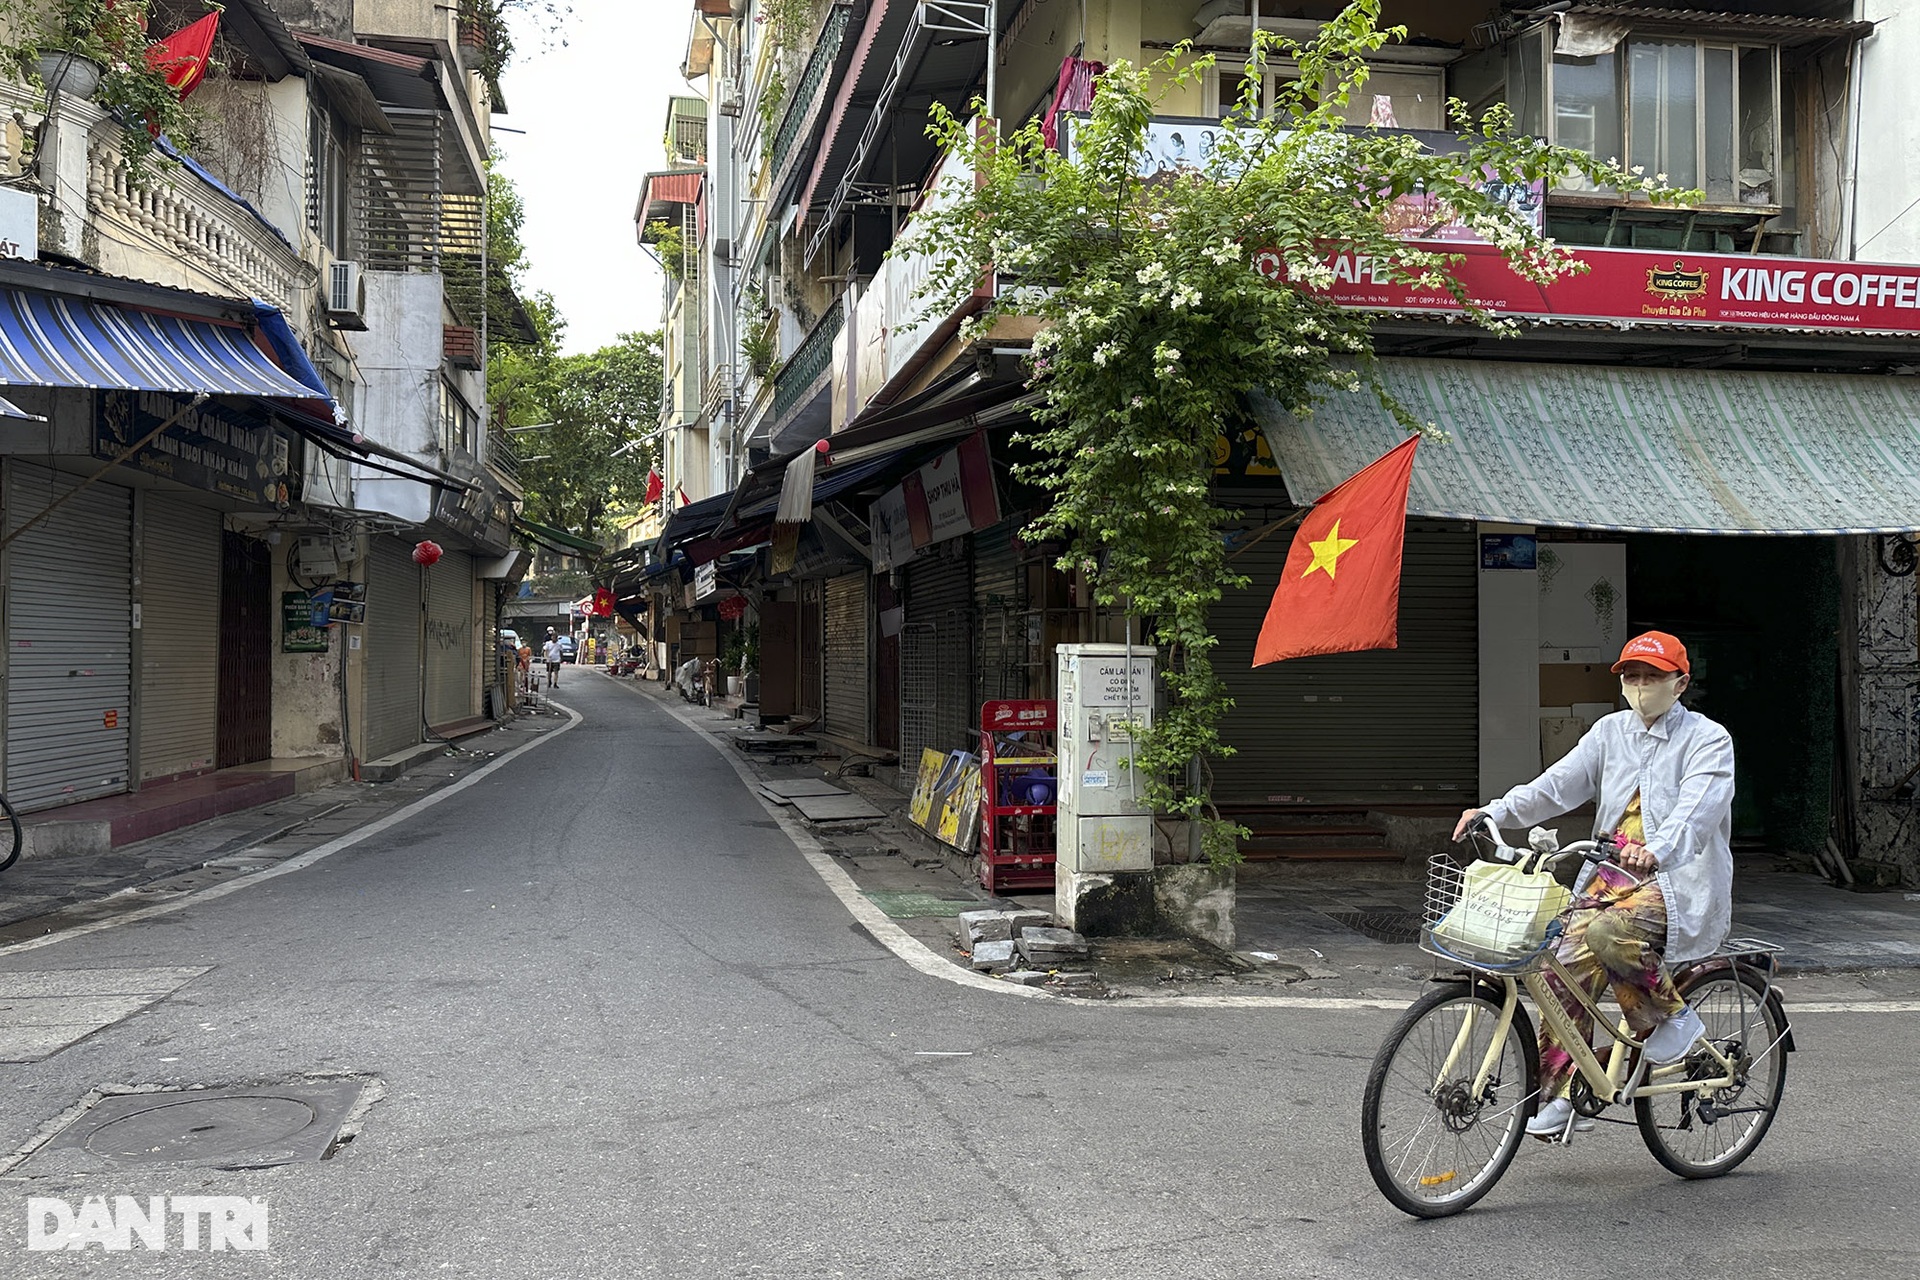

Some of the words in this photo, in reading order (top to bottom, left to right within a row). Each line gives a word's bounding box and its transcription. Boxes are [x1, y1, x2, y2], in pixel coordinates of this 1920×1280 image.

[1656, 279, 1673, 287] KING
[1673, 280, 1699, 288] COFFEE
[1721, 267, 1807, 303] KING
[1811, 272, 1920, 309] COFFE
[1436, 297, 1448, 305] 516
[1494, 300, 1507, 308] 402
[1642, 304, 1668, 317] Chuyên
[1669, 305, 1681, 316] Gia
[1682, 306, 1692, 316] Cà
[1693, 307, 1707, 317] Phê
[1100, 665, 1114, 676] CẤM
[1130, 665, 1142, 675] ẦN
[1109, 677, 1119, 685] CÓ
[1103, 693, 1120, 701] CHẾT
[1470, 902, 1513, 925] BEGINS
